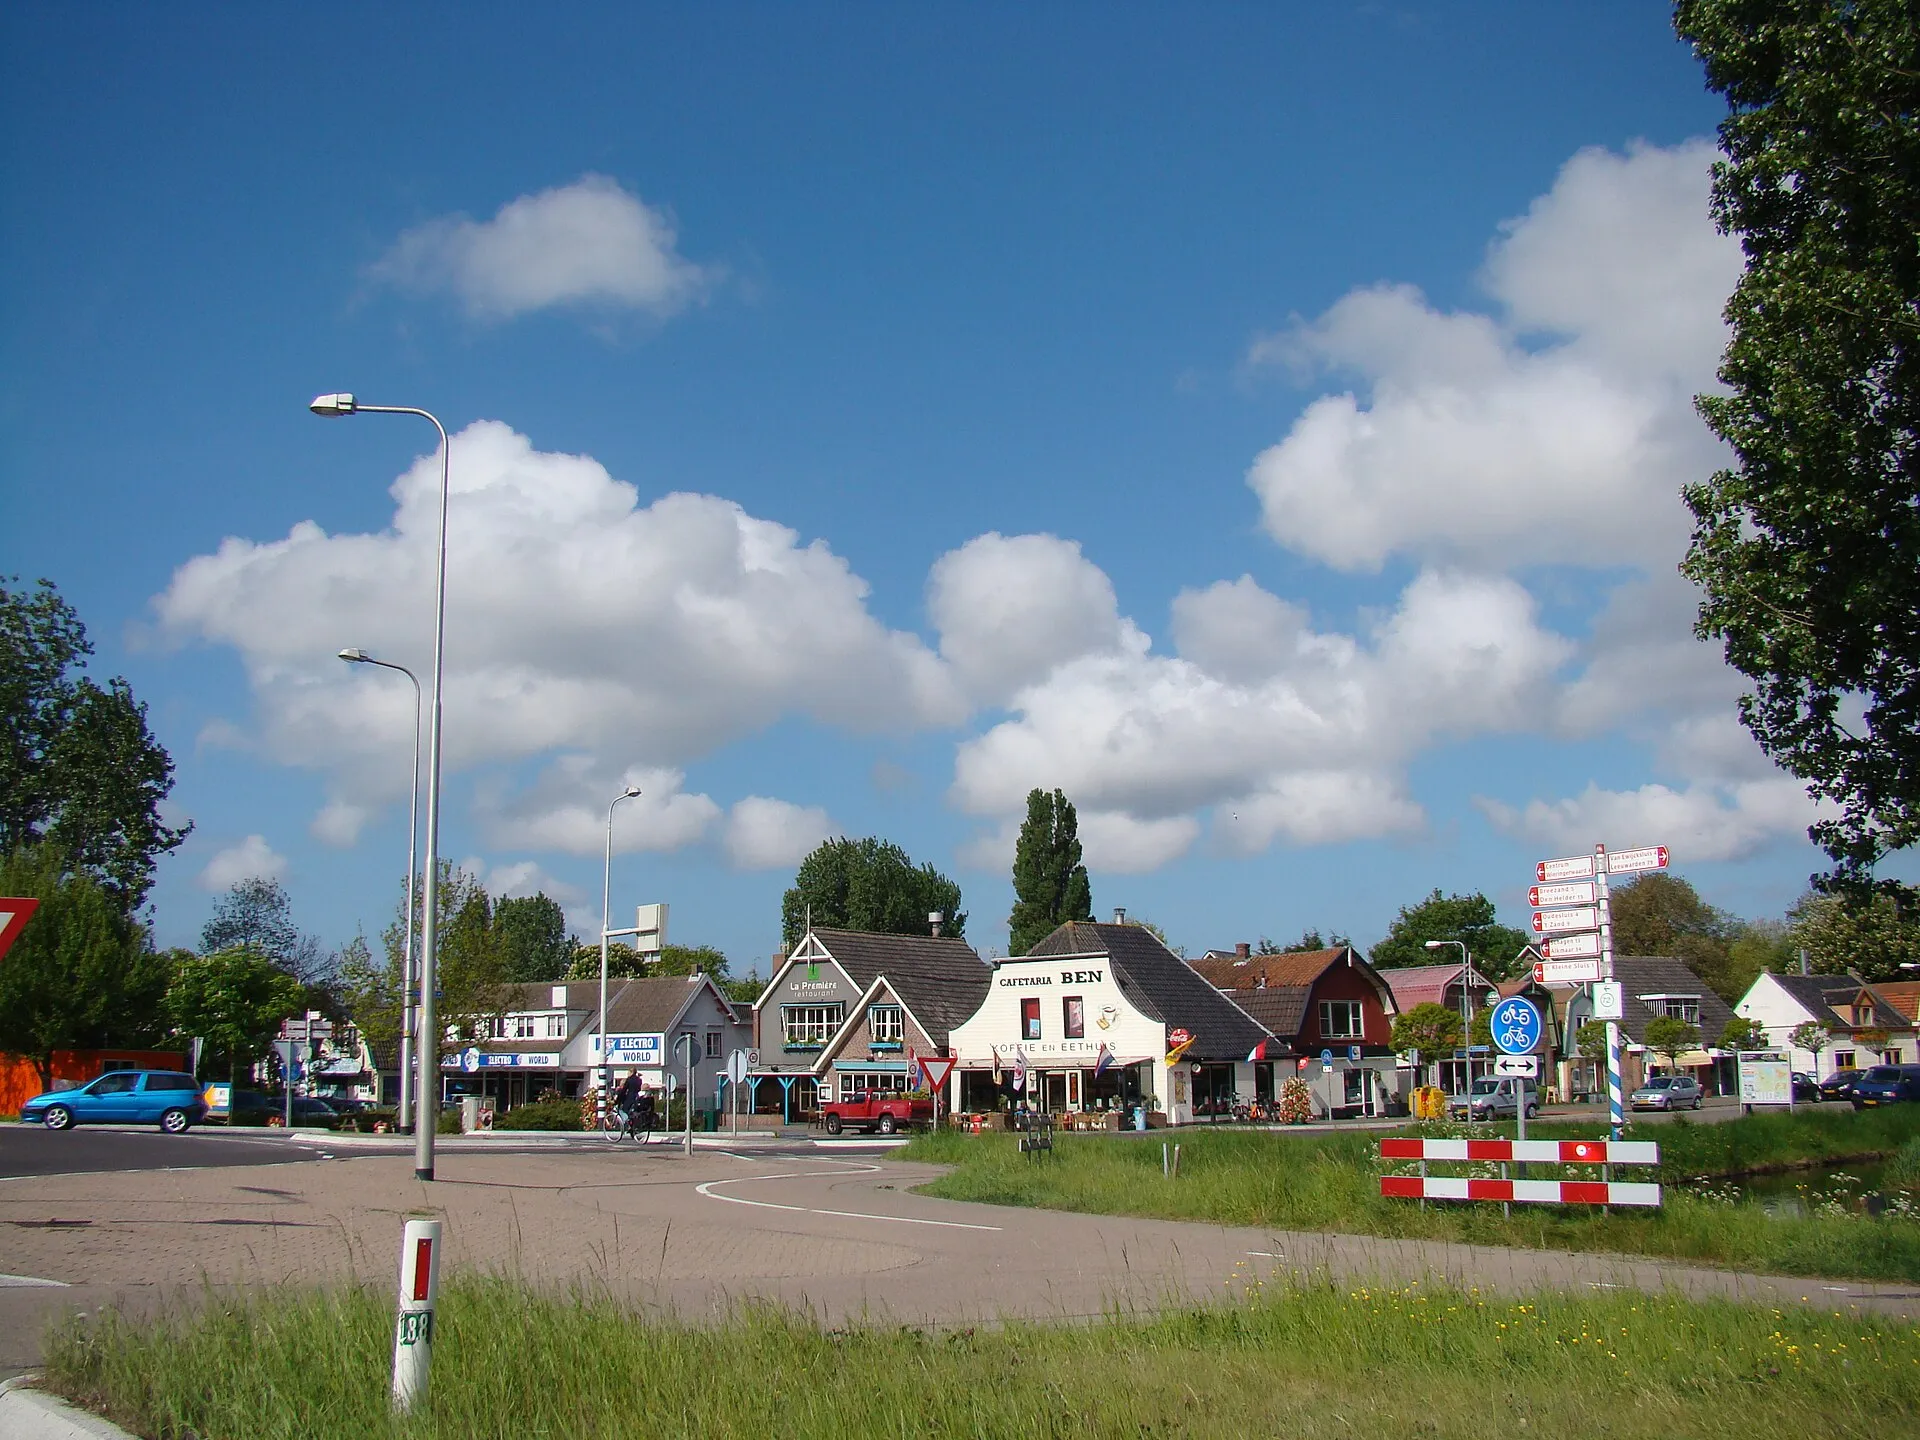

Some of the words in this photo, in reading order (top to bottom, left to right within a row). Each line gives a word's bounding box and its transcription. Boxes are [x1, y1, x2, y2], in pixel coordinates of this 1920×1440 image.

[1610, 861, 1646, 870] Leeuwarden
[1542, 912, 1574, 920] Oudesluis
[1550, 938, 1574, 946] Schagen
[999, 976, 1053, 987] CAFETARIA
[1060, 970, 1103, 984] BEN
[790, 982, 799, 990] La
[619, 1037, 654, 1049] ELECTRO
[991, 1043, 1036, 1052] KOFFIE
[1061, 1042, 1116, 1051] EETHUIS
[488, 1055, 512, 1065] ELECTRO
[528, 1055, 549, 1065] WORLD
[622, 1051, 651, 1062] WORLD
